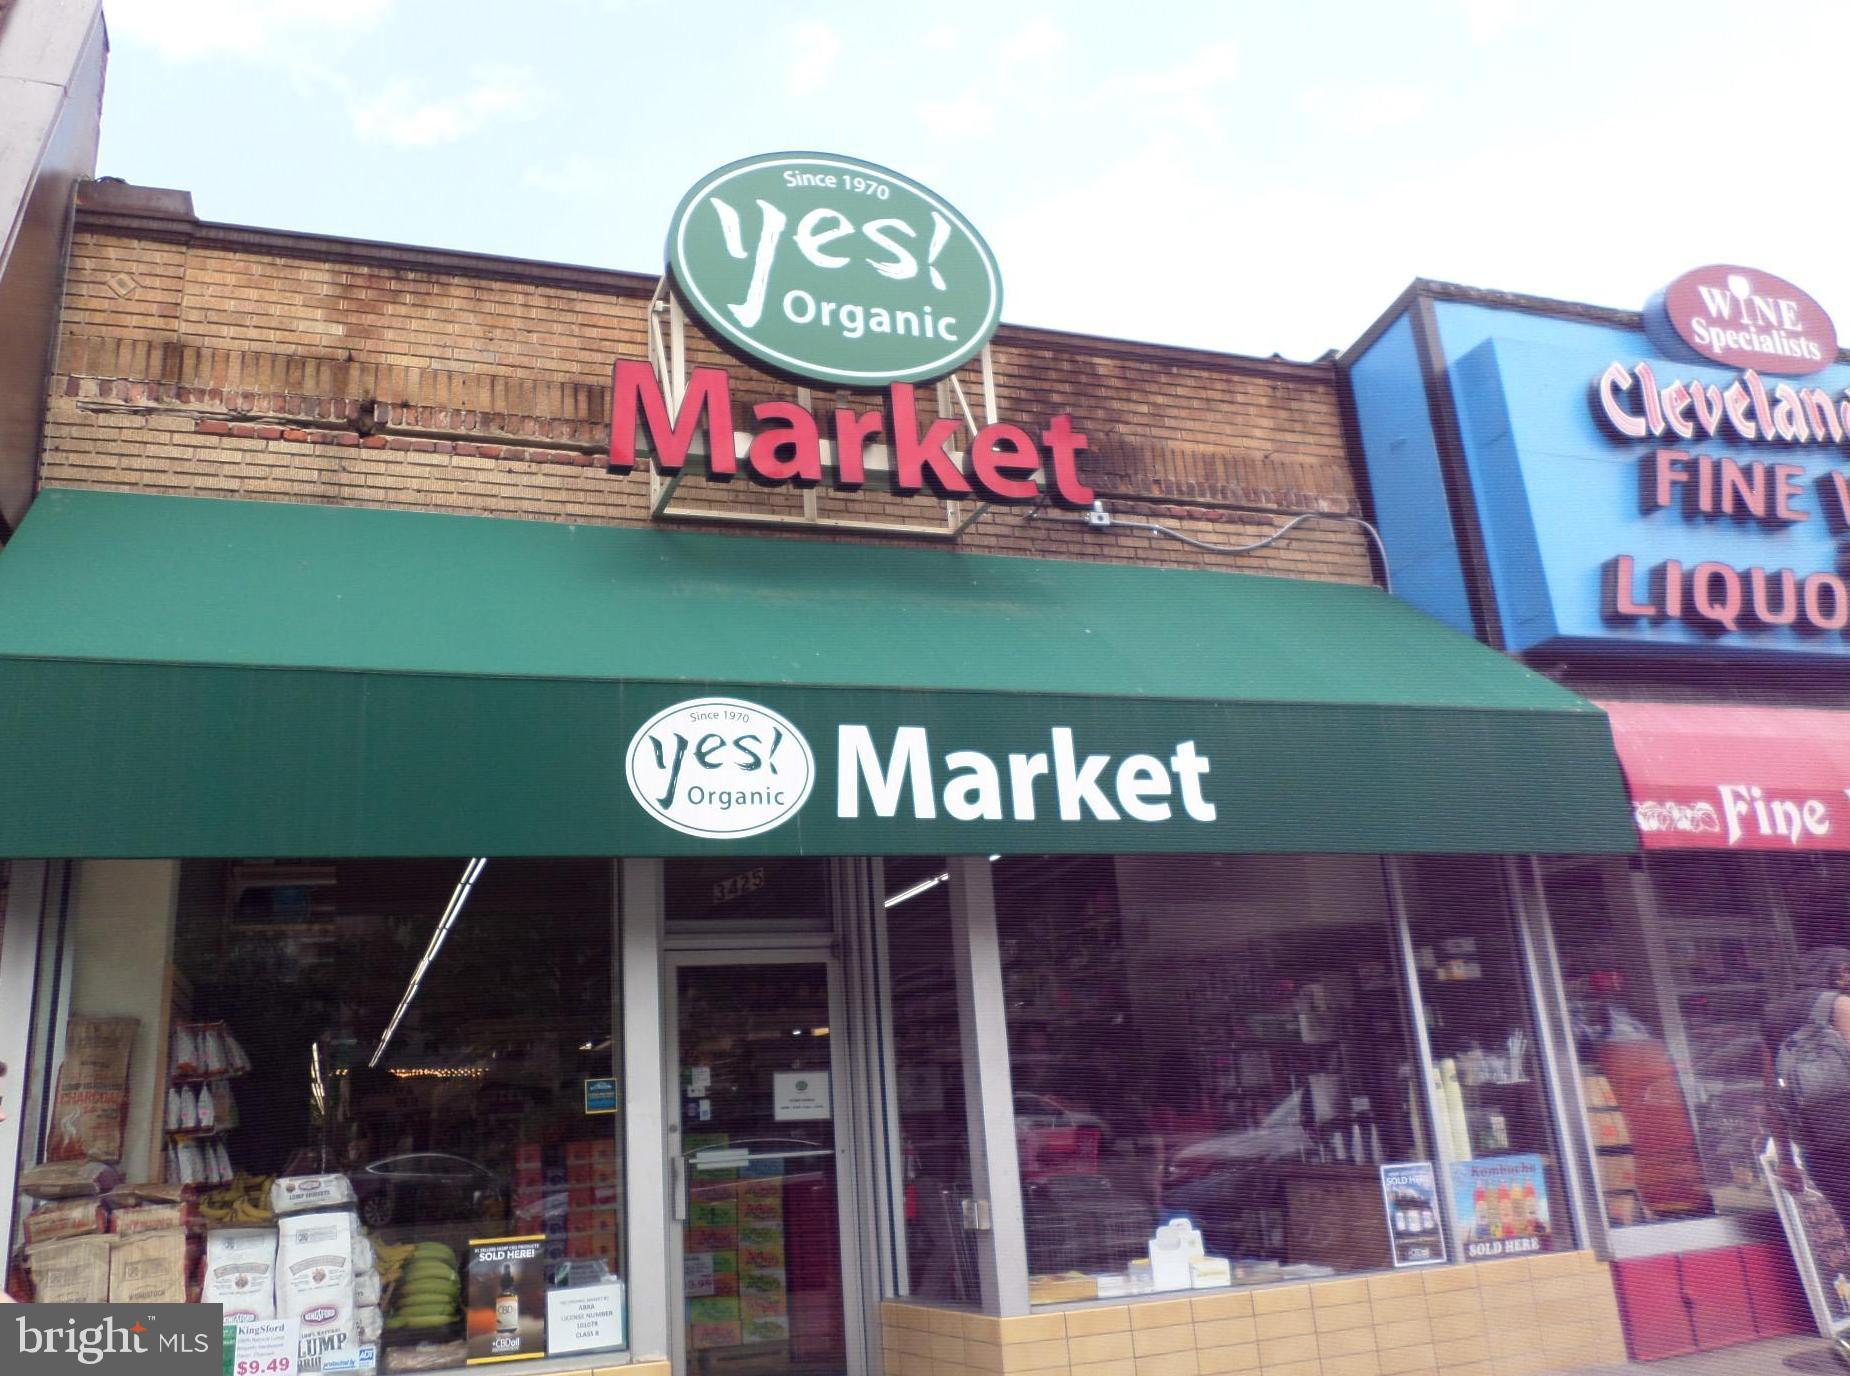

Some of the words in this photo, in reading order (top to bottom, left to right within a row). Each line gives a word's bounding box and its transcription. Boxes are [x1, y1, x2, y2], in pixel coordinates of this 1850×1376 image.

[783, 170, 837, 190] Since
[842, 175, 890, 200] 1970
[782, 289, 959, 342] Organic
[1691, 317, 1823, 361] Specialists
[608, 358, 1095, 505] Market
[1656, 448, 1809, 522] FINE
[689, 711, 719, 723] Since
[723, 710, 750, 723] 1970
[837, 724, 1217, 822] Market
[687, 785, 786, 806] Organic
[1717, 784, 1830, 846] Fine
[1386, 1175, 1409, 1186] SOLD
[479, 1250, 506, 1262] SOLD
[506, 1248, 535, 1260] HERE!
[1468, 1239, 1503, 1257] SOLD
[1504, 1236, 1541, 1253] HERE
[239, 1323, 285, 1336] KingSford
[298, 1332, 347, 1358] LUMP
[236, 1356, 290, 1376] $9.49
